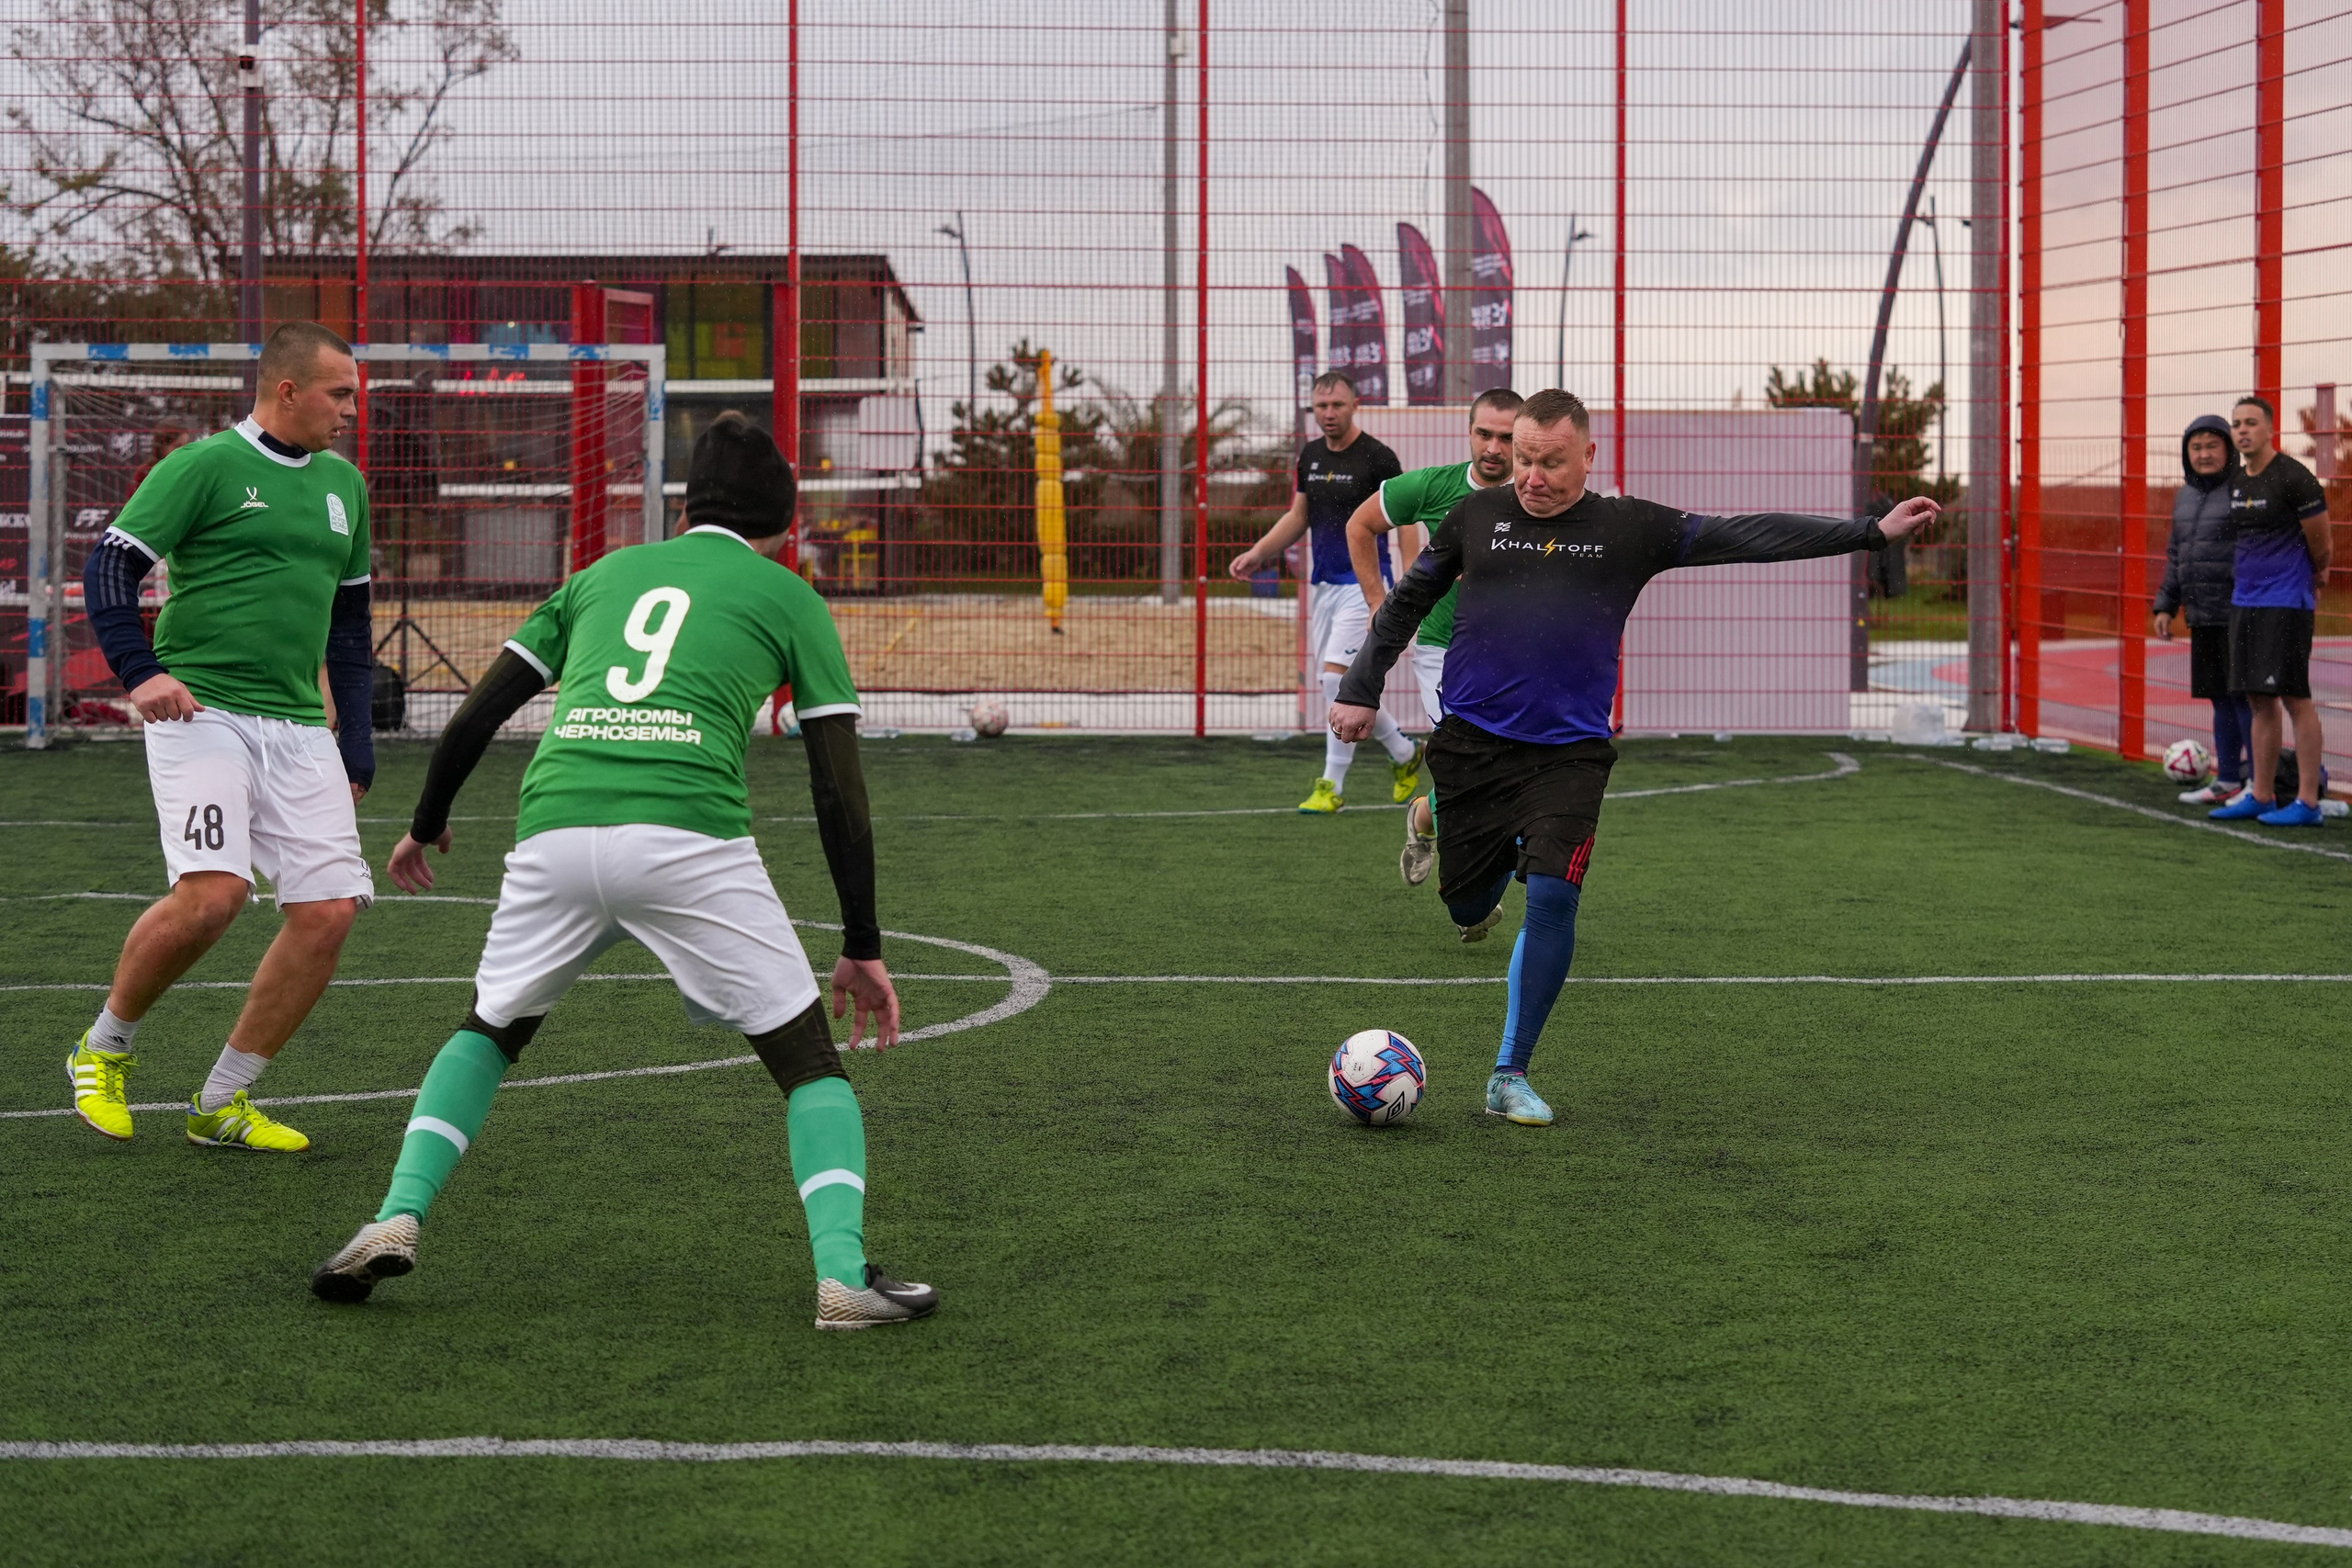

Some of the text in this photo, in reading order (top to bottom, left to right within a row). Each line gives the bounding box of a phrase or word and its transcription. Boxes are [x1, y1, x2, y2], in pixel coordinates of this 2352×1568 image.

[605, 586, 691, 704] 9
[566, 706, 693, 726] АГРОНОМЫ
[554, 724, 702, 745] ЧЕРНОЗЕМЬЯ
[184, 803, 225, 851] 48
